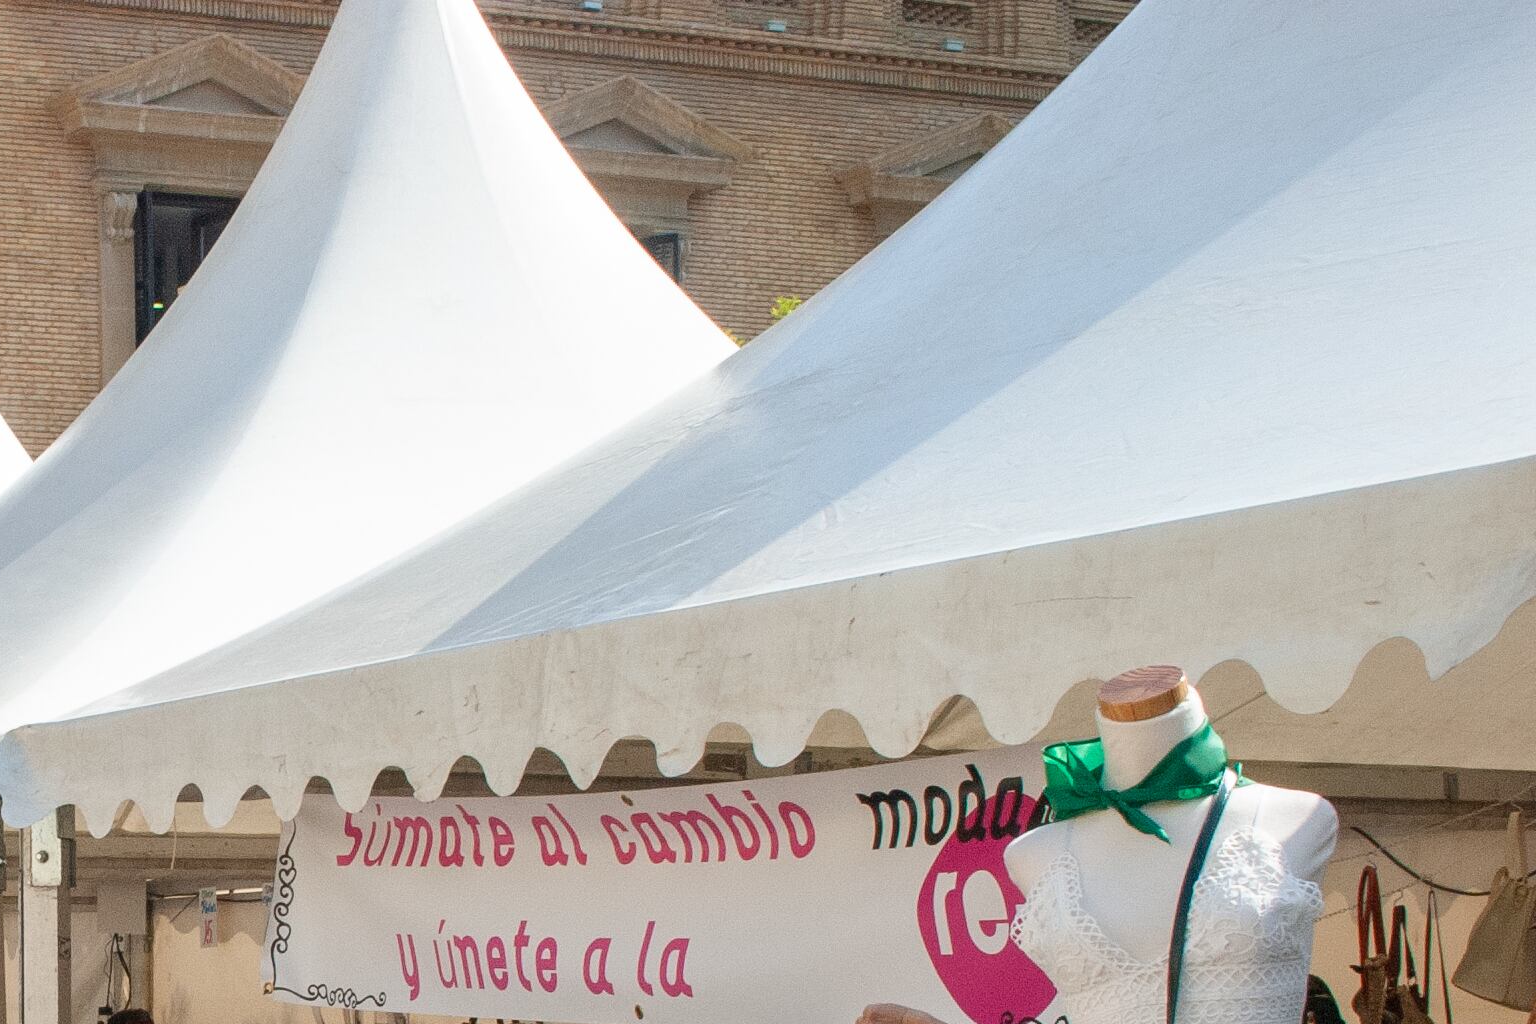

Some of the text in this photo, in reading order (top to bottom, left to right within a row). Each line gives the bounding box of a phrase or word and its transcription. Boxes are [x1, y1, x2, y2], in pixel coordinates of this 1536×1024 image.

[336, 790, 817, 867] Súmate al cambio
[855, 764, 1024, 850] moda
[396, 919, 694, 1001] y únete a la
